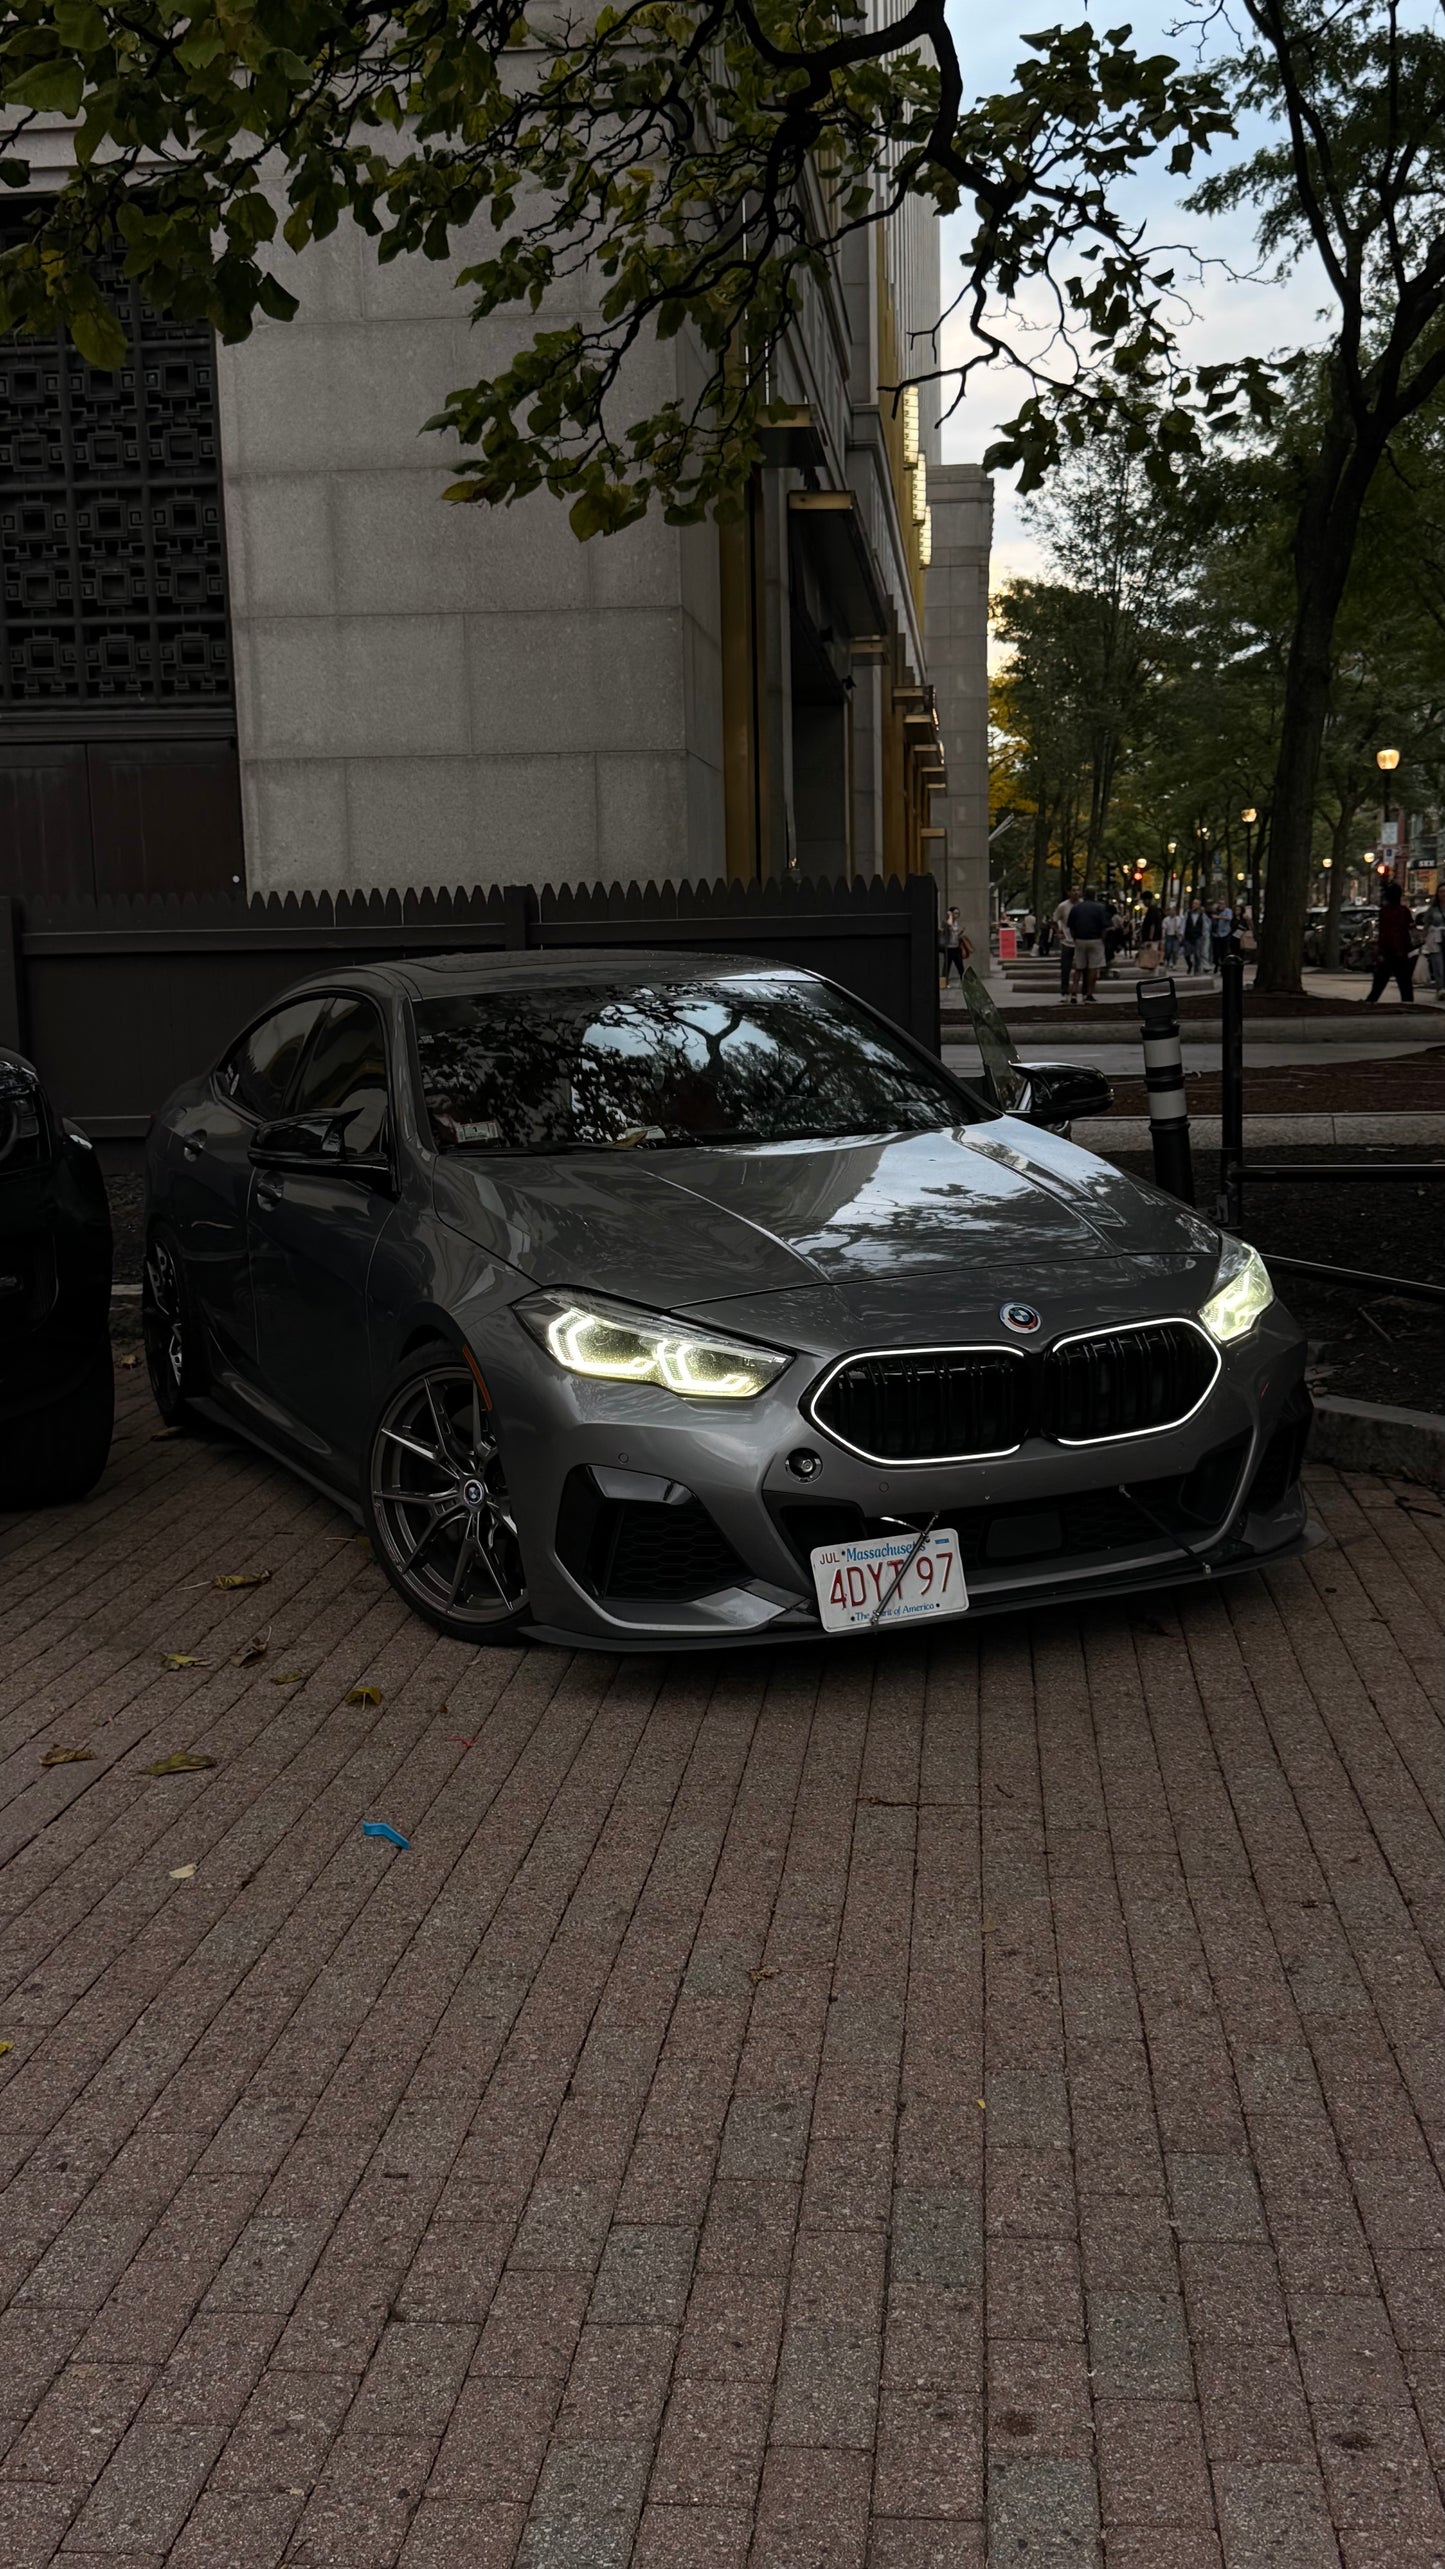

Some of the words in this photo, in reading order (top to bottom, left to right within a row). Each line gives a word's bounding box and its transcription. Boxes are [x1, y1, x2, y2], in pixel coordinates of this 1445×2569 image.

[820, 1552, 840, 1565] JUL
[846, 1541, 926, 1562] Massachusets
[830, 1559, 905, 1610] 4DYT
[916, 1552, 953, 1596] 97
[855, 1611, 870, 1621] The
[893, 1605, 901, 1616] of
[902, 1603, 935, 1614] America
